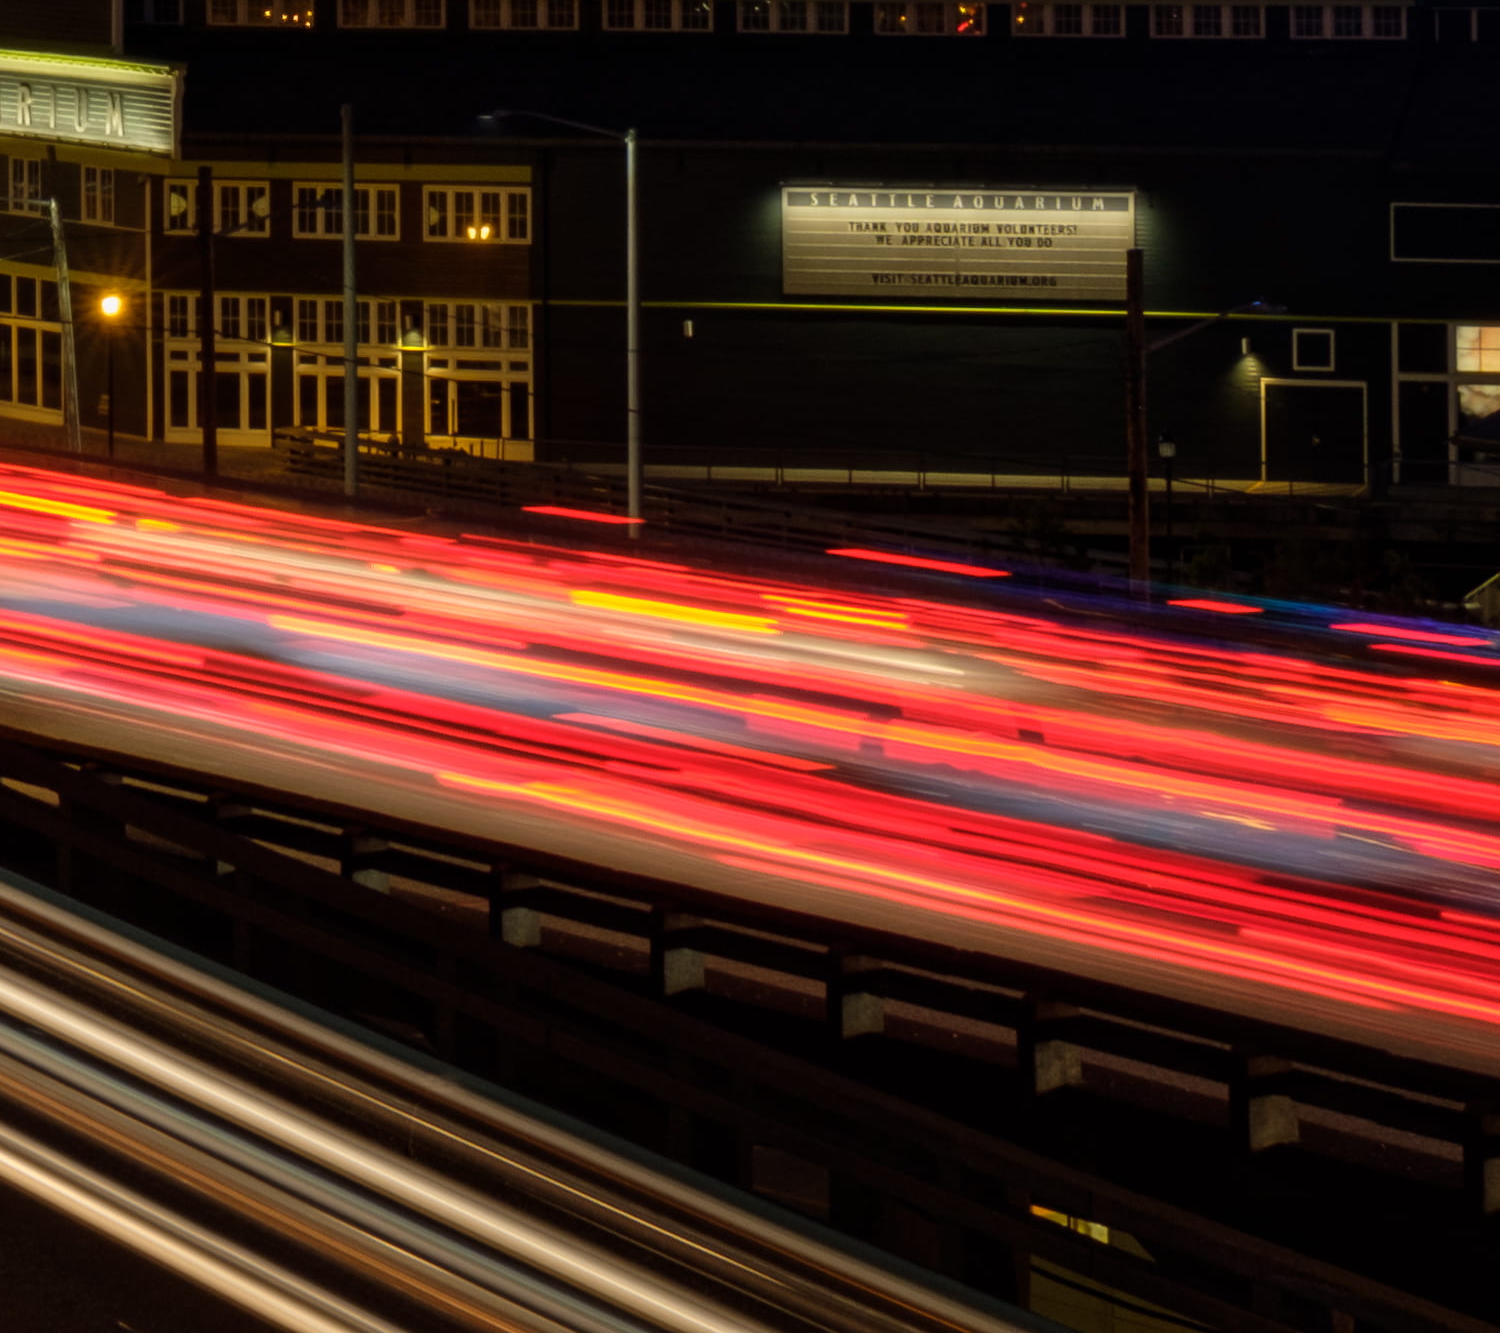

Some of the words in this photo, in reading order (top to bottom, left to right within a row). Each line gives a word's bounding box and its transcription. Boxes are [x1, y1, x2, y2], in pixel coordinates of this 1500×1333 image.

[809, 192, 936, 209] SEATTLE
[952, 195, 1105, 211] AQUARIUM
[848, 221, 887, 232] THANK
[894, 222, 919, 233] YOU
[925, 222, 990, 234] AQUARIUM
[875, 234, 893, 245] WE
[901, 235, 975, 247] APPRECIATE
[981, 236, 1001, 247] ALL
[1008, 237, 1032, 247] YOU
[1037, 238, 1053, 248] DO
[872, 272, 903, 284] VISIT
[911, 273, 1057, 286] SEATTLEAQUARIUM.ORG
